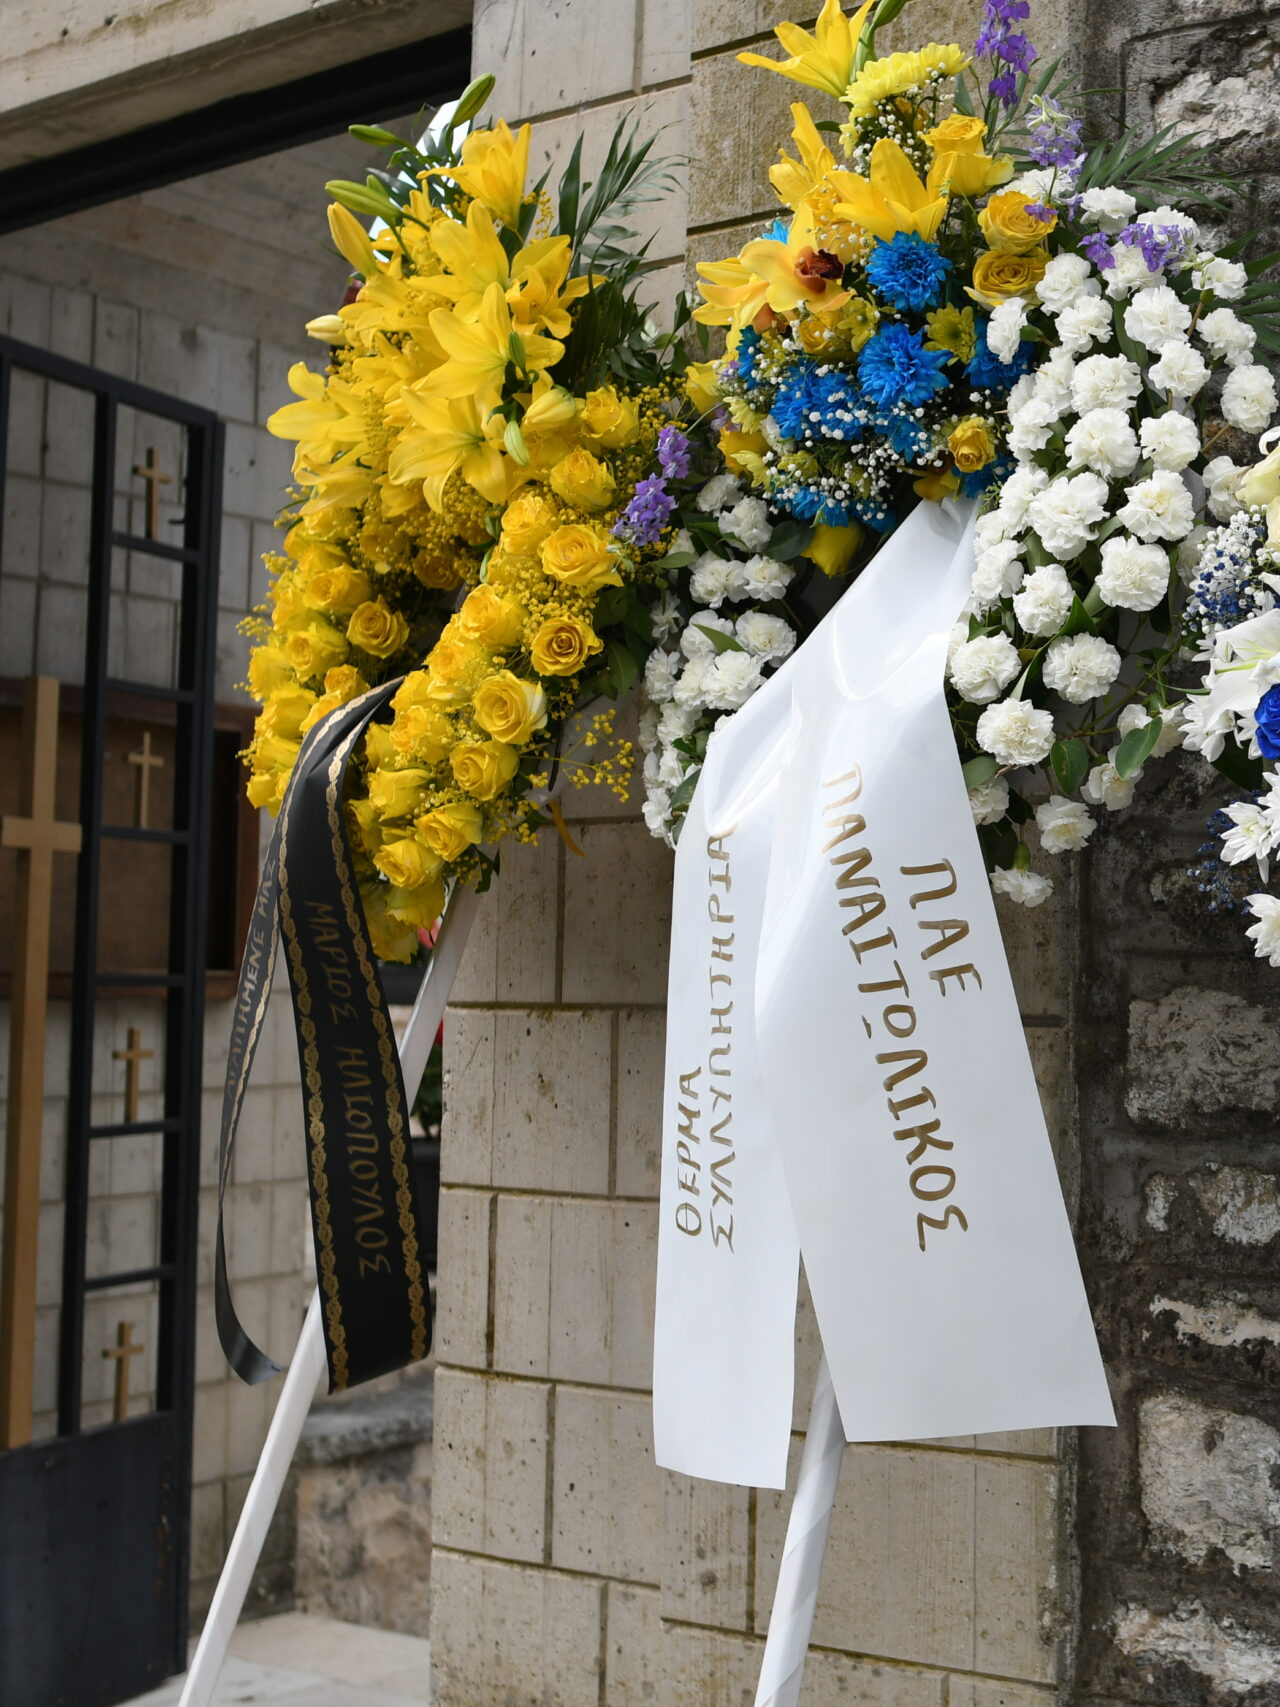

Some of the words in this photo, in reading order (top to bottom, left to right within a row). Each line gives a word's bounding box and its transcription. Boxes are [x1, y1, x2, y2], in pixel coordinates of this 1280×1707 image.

[707, 821, 737, 1253] ΣΥΛΛΥΠΗΤΗΡΙΑ
[899, 857, 982, 997] ΠΑΕ
[304, 900, 360, 1025] ΜΑΡΙΟΣ
[335, 1045, 392, 1278] ΗΛΙΟΠΟΥΛΟΣ
[675, 1065, 702, 1238] ΘΕΡΜΑ
